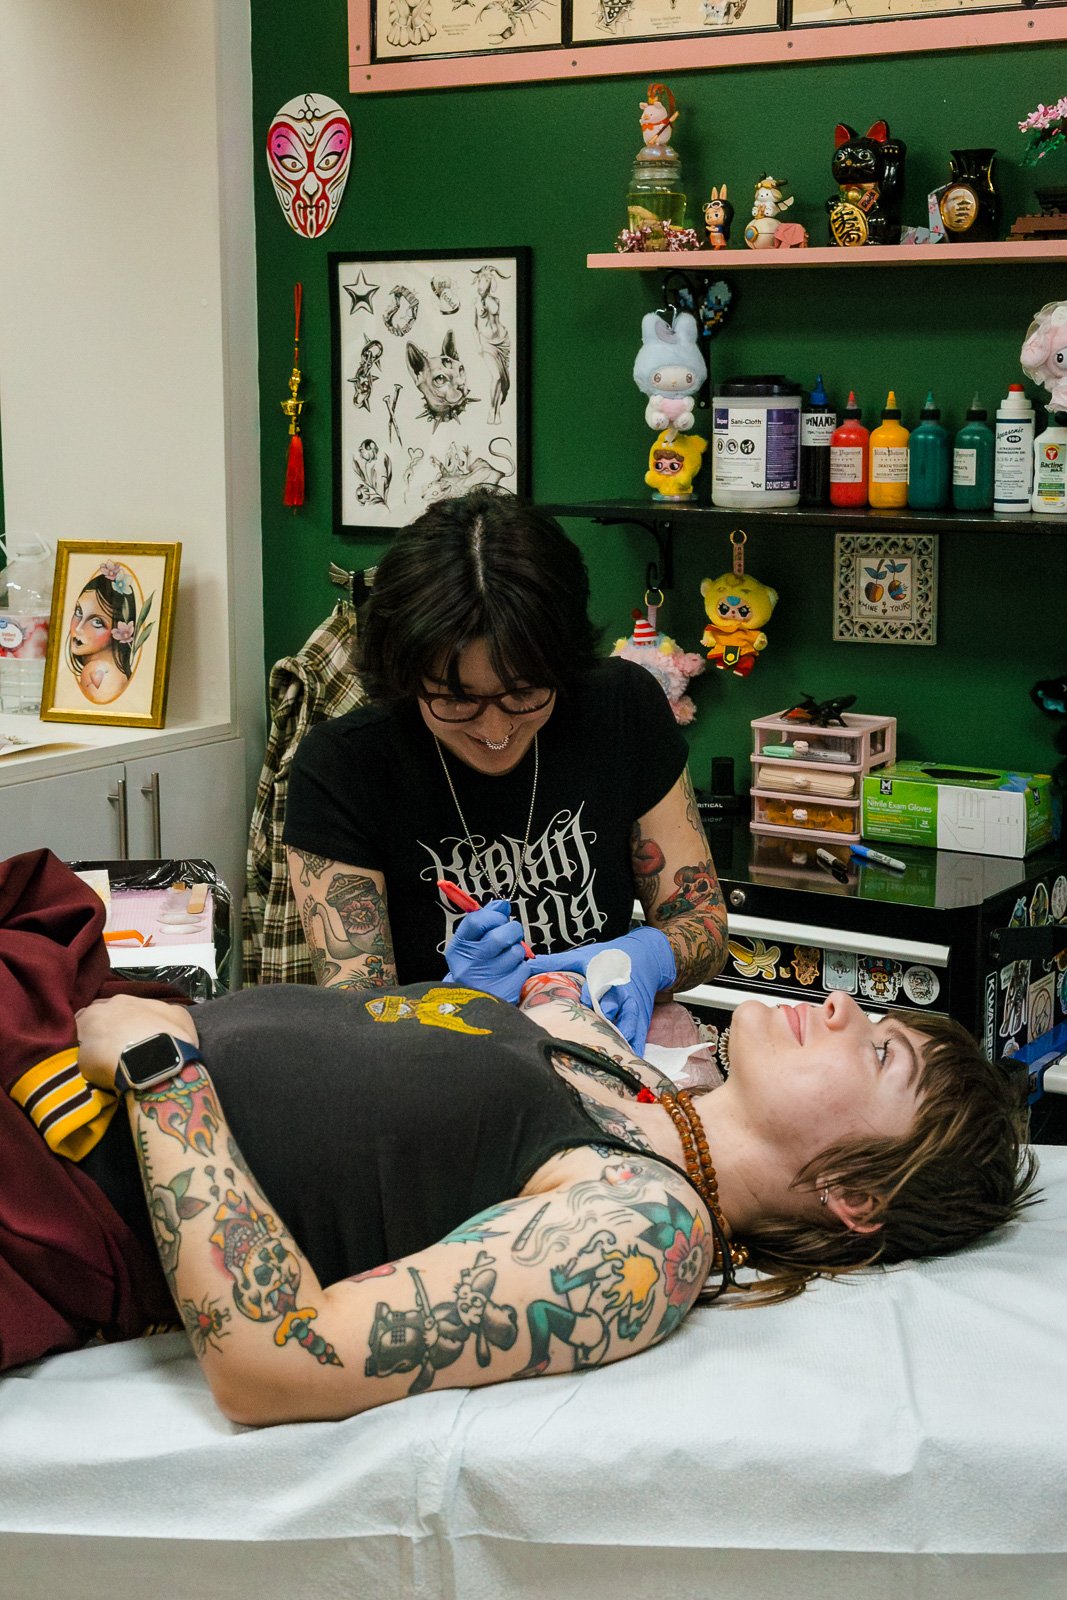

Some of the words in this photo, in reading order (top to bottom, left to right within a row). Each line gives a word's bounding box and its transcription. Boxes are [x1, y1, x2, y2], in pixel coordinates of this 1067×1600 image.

[805, 416, 835, 427] DYNAMIC
[1040, 461, 1063, 469] Bactine
[866, 799, 887, 808] Nitrile
[888, 801, 907, 810] Exam
[907, 803, 932, 813] Gloves
[986, 978, 996, 1063] KWADRO
